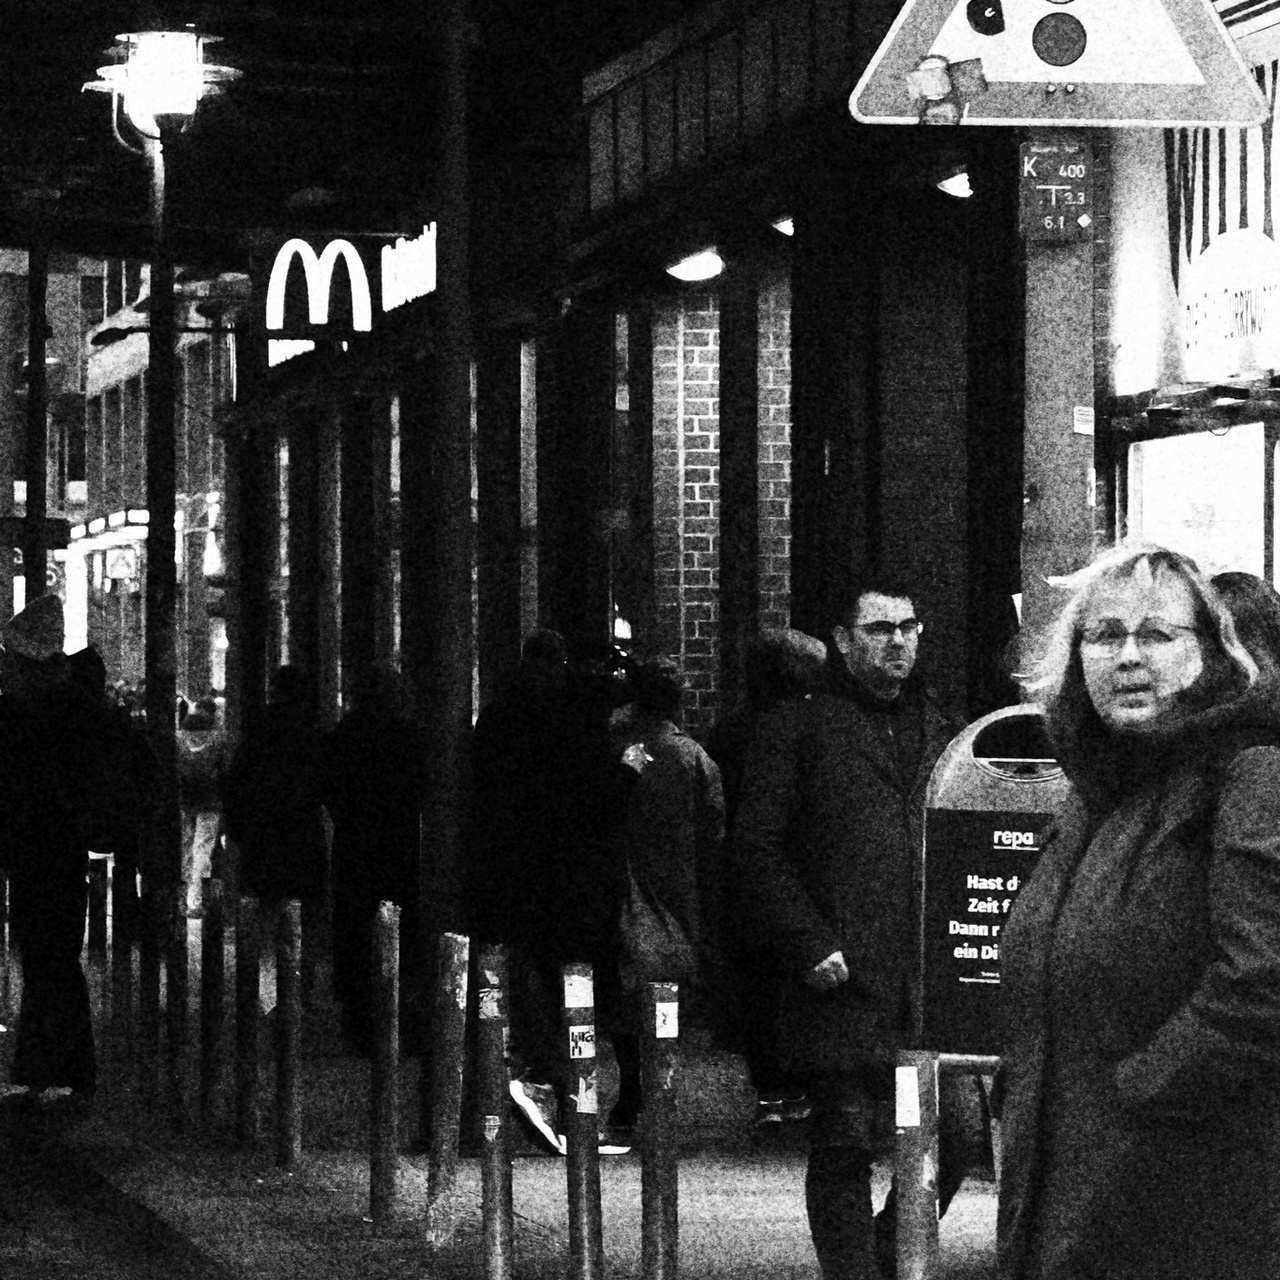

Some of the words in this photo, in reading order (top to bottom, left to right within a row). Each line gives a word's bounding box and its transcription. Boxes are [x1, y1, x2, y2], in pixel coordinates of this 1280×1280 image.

[1024, 156, 1037, 177] K
[1059, 164, 1085, 178] 400
[966, 874, 1004, 890] Hast
[1006, 876, 1021, 891] d
[967, 897, 999, 914] Zeit
[948, 920, 989, 937] Dann
[953, 942, 978, 959] ein
